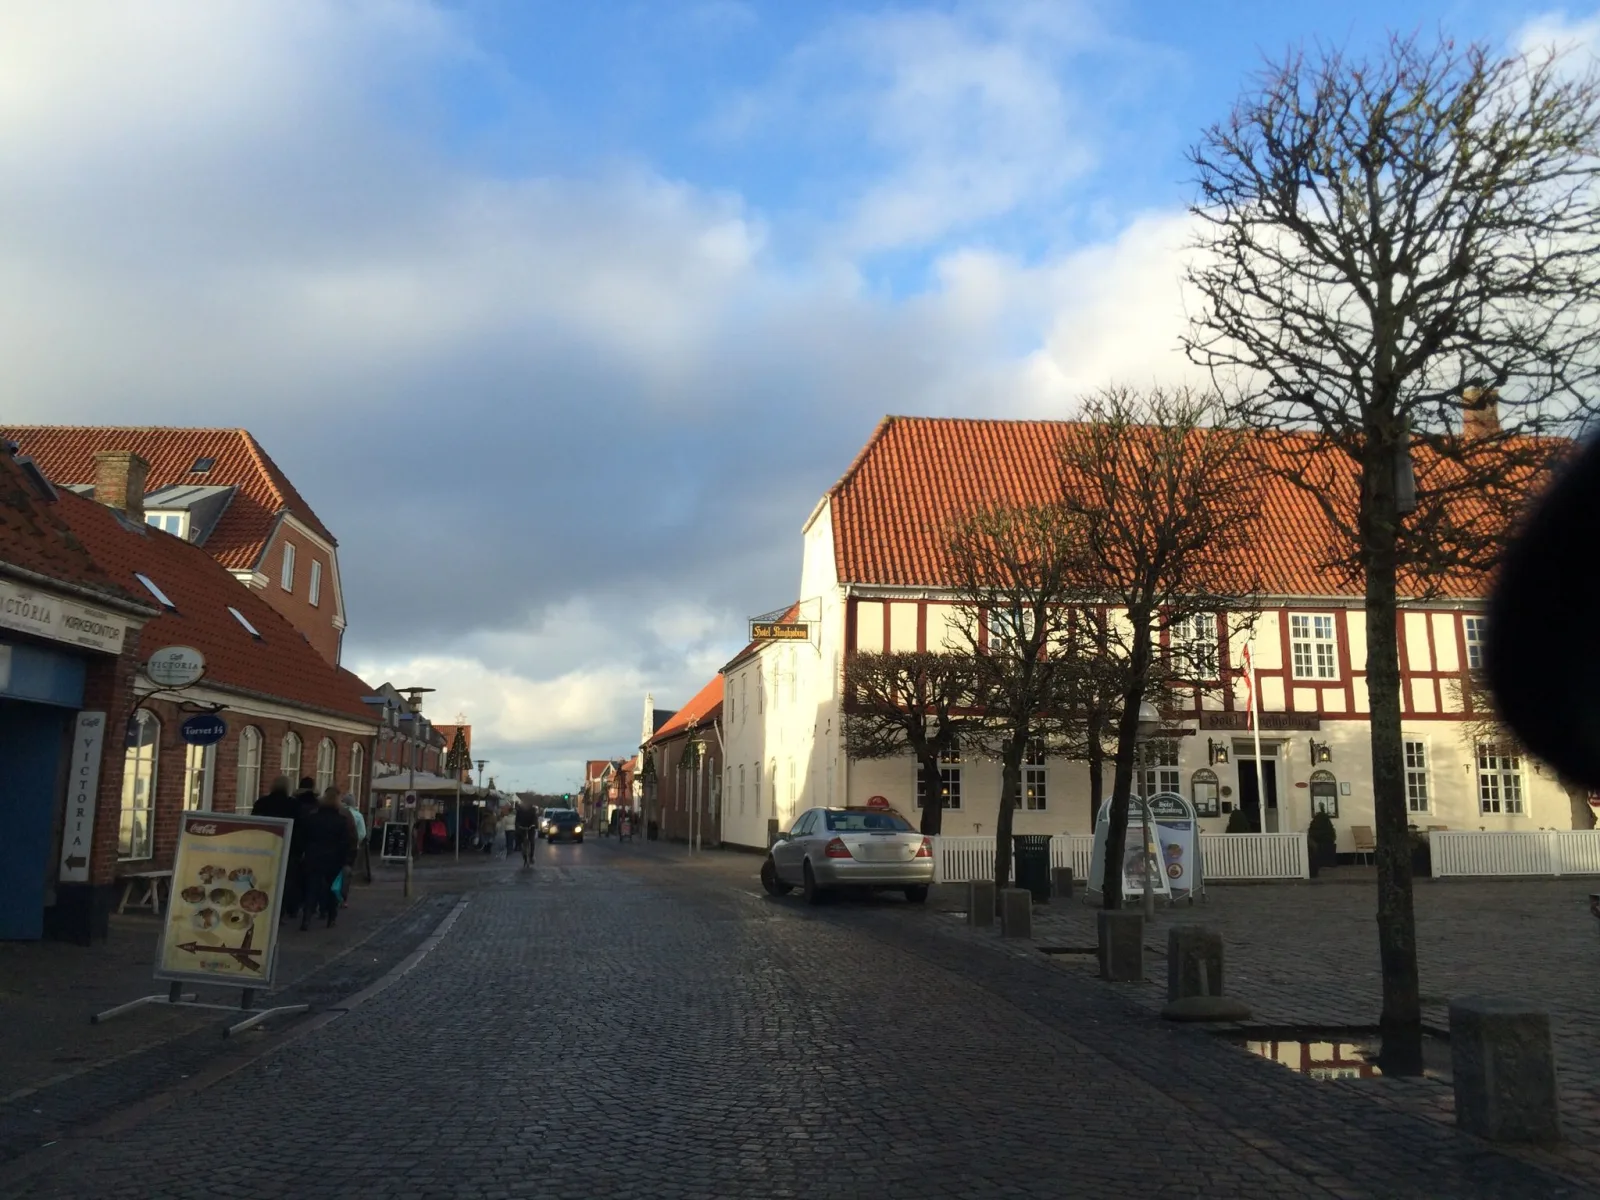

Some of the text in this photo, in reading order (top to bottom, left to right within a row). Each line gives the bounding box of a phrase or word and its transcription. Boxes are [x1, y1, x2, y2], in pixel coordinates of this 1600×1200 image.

[0, 597, 51, 624] ICTORIA
[151, 661, 199, 670] VICTORIA
[184, 726, 212, 735] Torvet
[72, 737, 94, 847] VICTORIA
